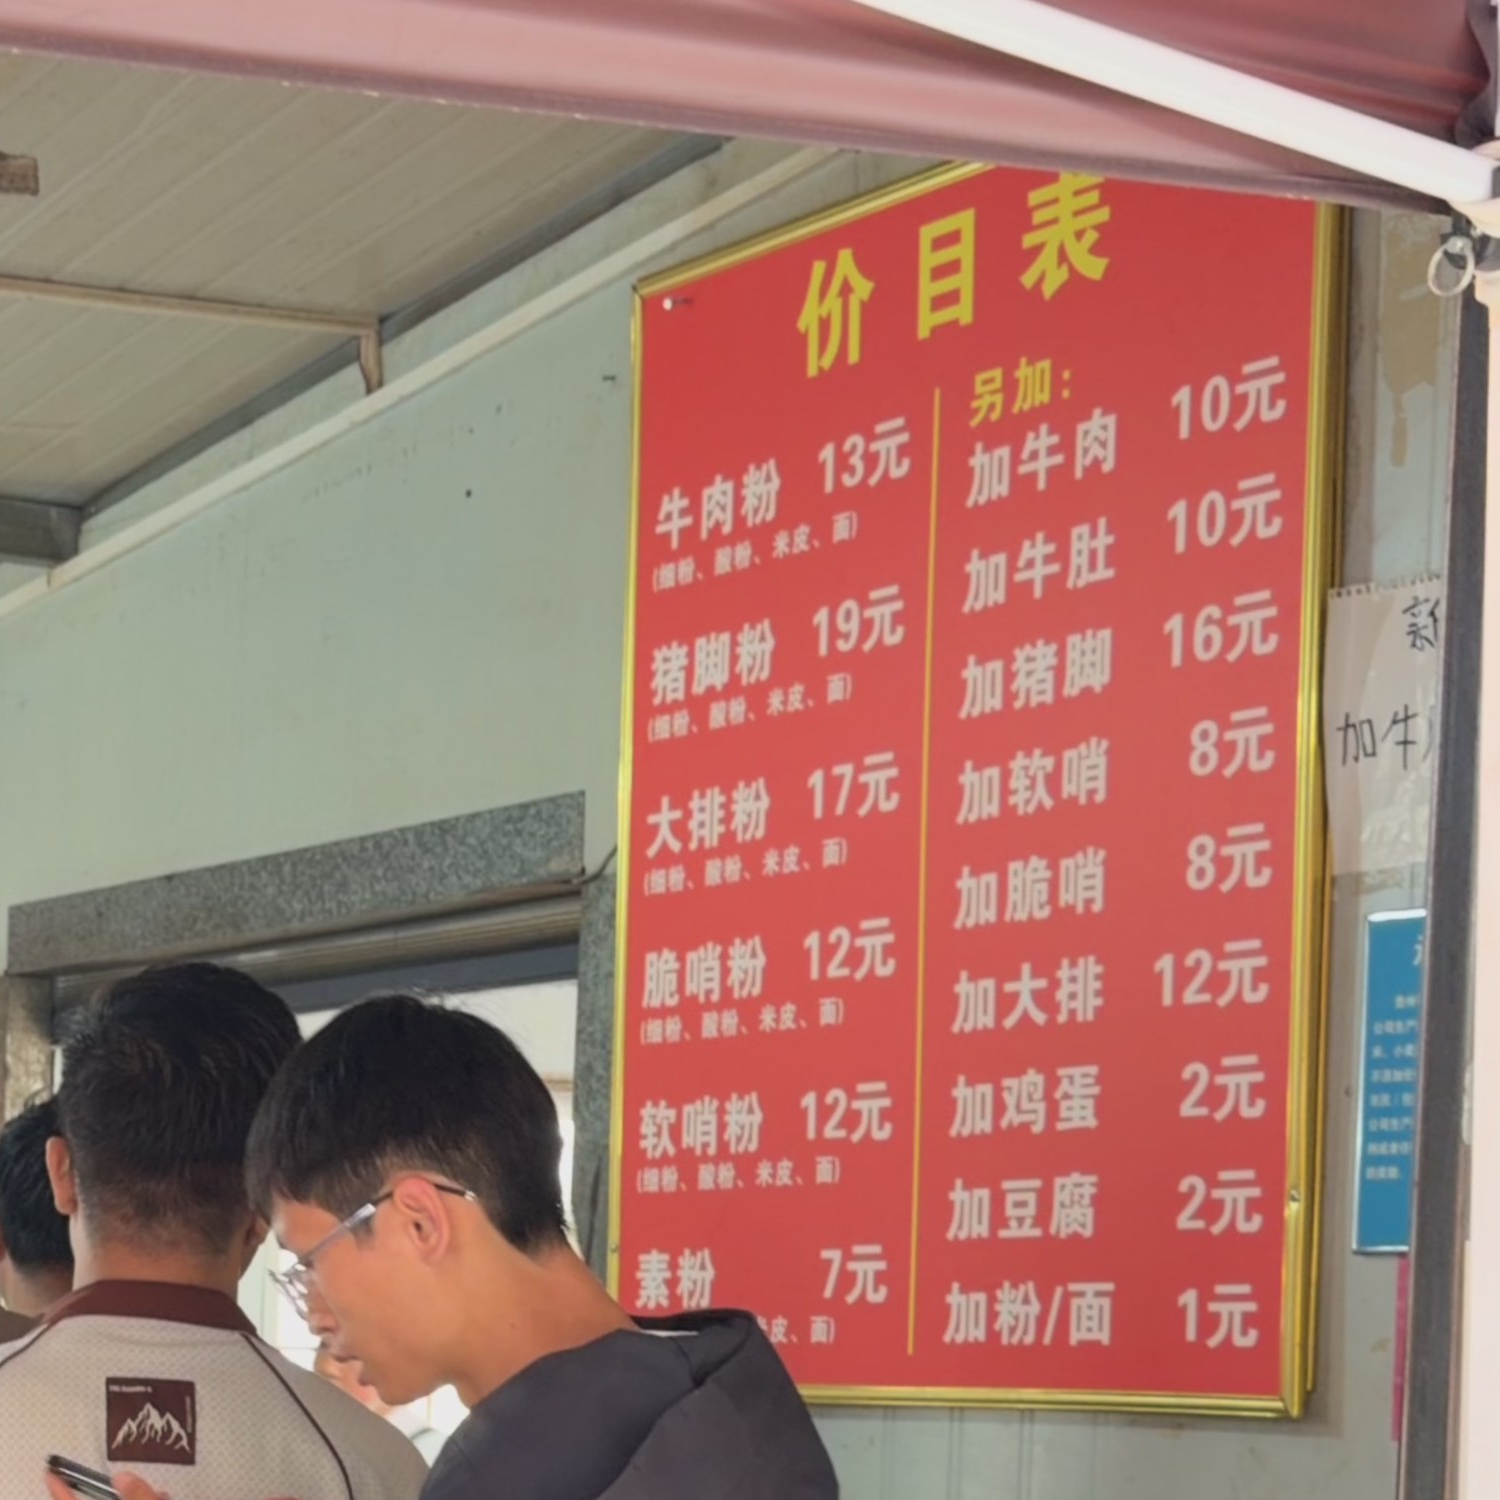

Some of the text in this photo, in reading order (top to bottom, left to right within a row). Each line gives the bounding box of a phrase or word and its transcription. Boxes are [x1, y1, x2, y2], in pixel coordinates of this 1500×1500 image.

[796, 169, 1111, 379] 价目表
[654, 416, 911, 551] 牛肉粉 13元
[966, 355, 1287, 508] 加牛肉 10元
[962, 472, 1283, 614] 加牛肚 10元
[650, 584, 905, 706] 猪脚粉 19元
[959, 590, 1279, 719] 加猪脚 16元
[955, 706, 1275, 825] 加软哨 8元
[1336, 704, 1434, 770] 加牛
[646, 751, 899, 858] 大排粉 17元
[953, 823, 1272, 930] 加脆哨 8元
[641, 917, 896, 1010] 脆哨粉 12元
[952, 939, 1269, 1034] 加大排 12元
[639, 1081, 893, 1159] 软哨粉 12元
[949, 1054, 1266, 1138] 加鸡蛋 2元
[946, 1169, 1263, 1241] 加豆腐 2元
[635, 1245, 889, 1310] 素粉 7元
[943, 1281, 1259, 1349] 加粉/面 1元
